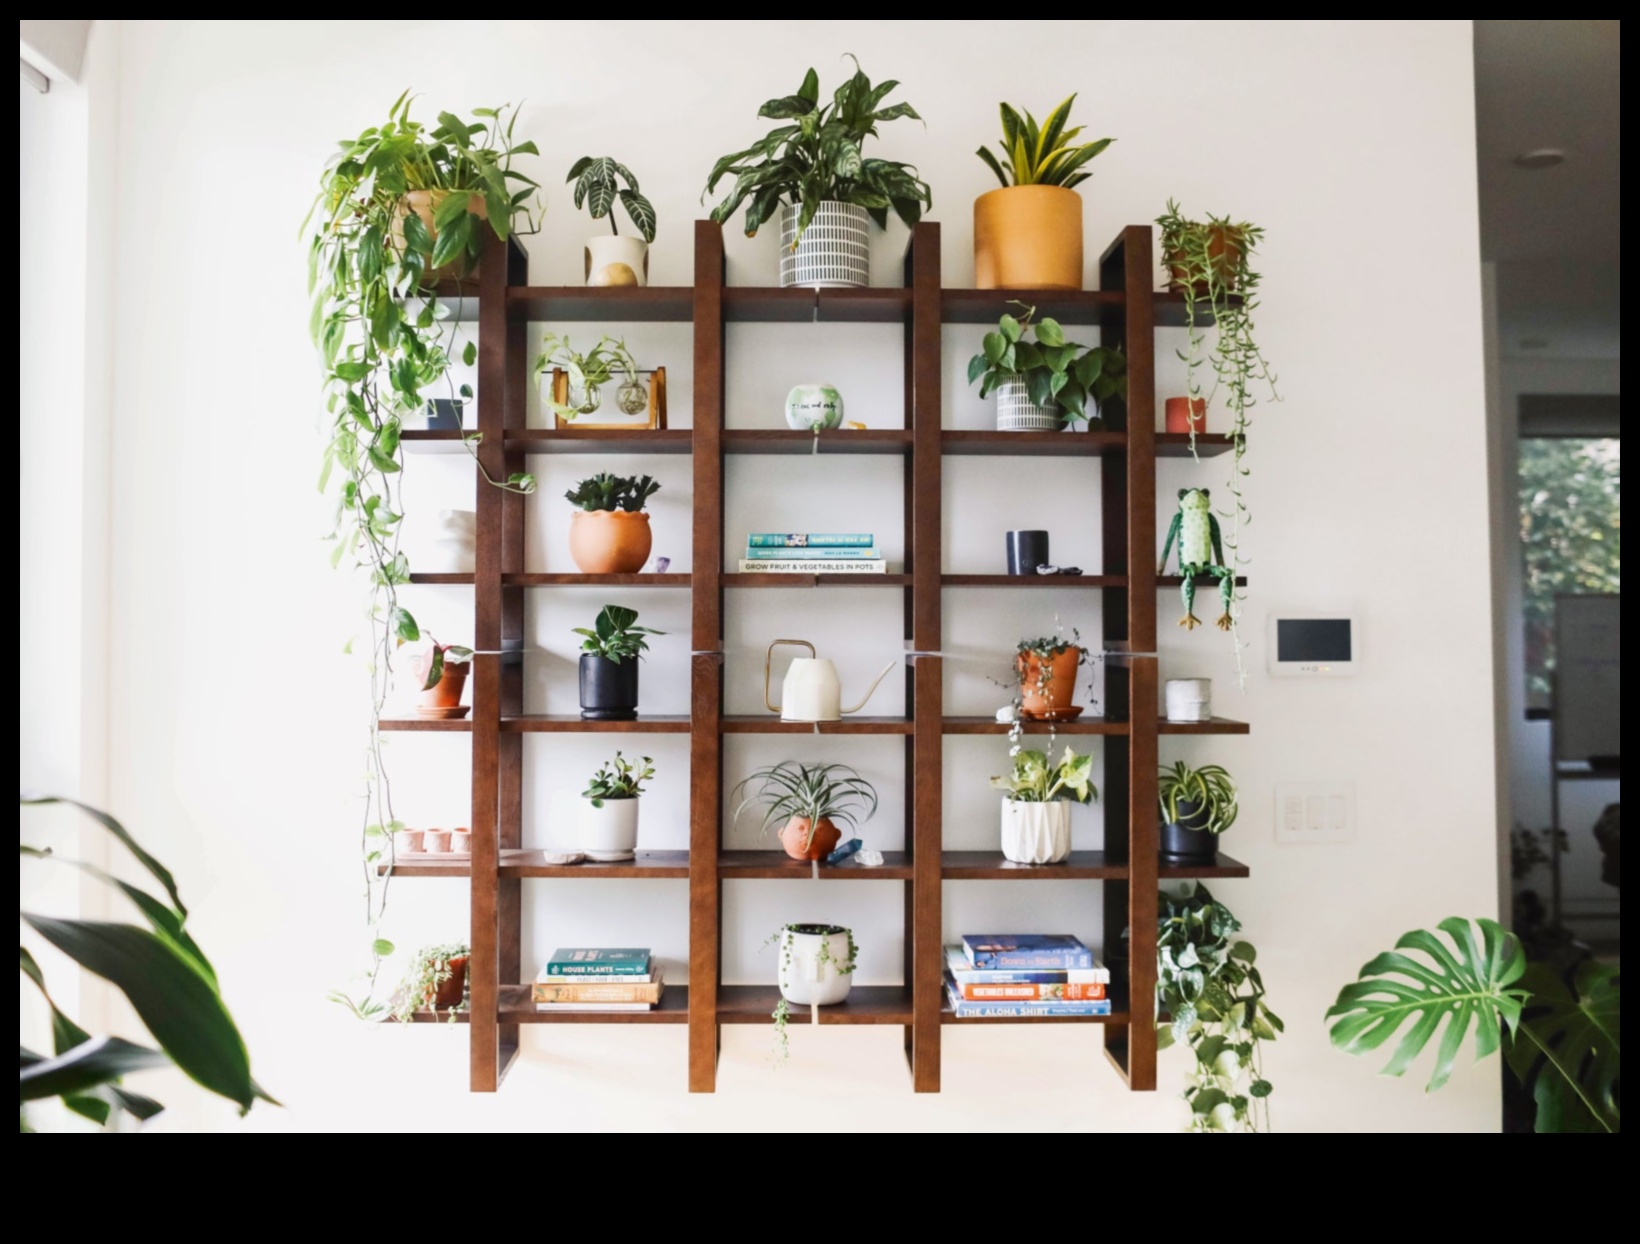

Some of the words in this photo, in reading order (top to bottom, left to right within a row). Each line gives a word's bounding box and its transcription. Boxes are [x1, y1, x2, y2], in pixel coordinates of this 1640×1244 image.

[1000, 957, 1026, 966] Down
[1035, 956, 1061, 966] Earth
[963, 1007, 983, 1016] THE
[985, 1007, 1018, 1016] ALOHA
[1020, 1006, 1049, 1016] SHIRT
